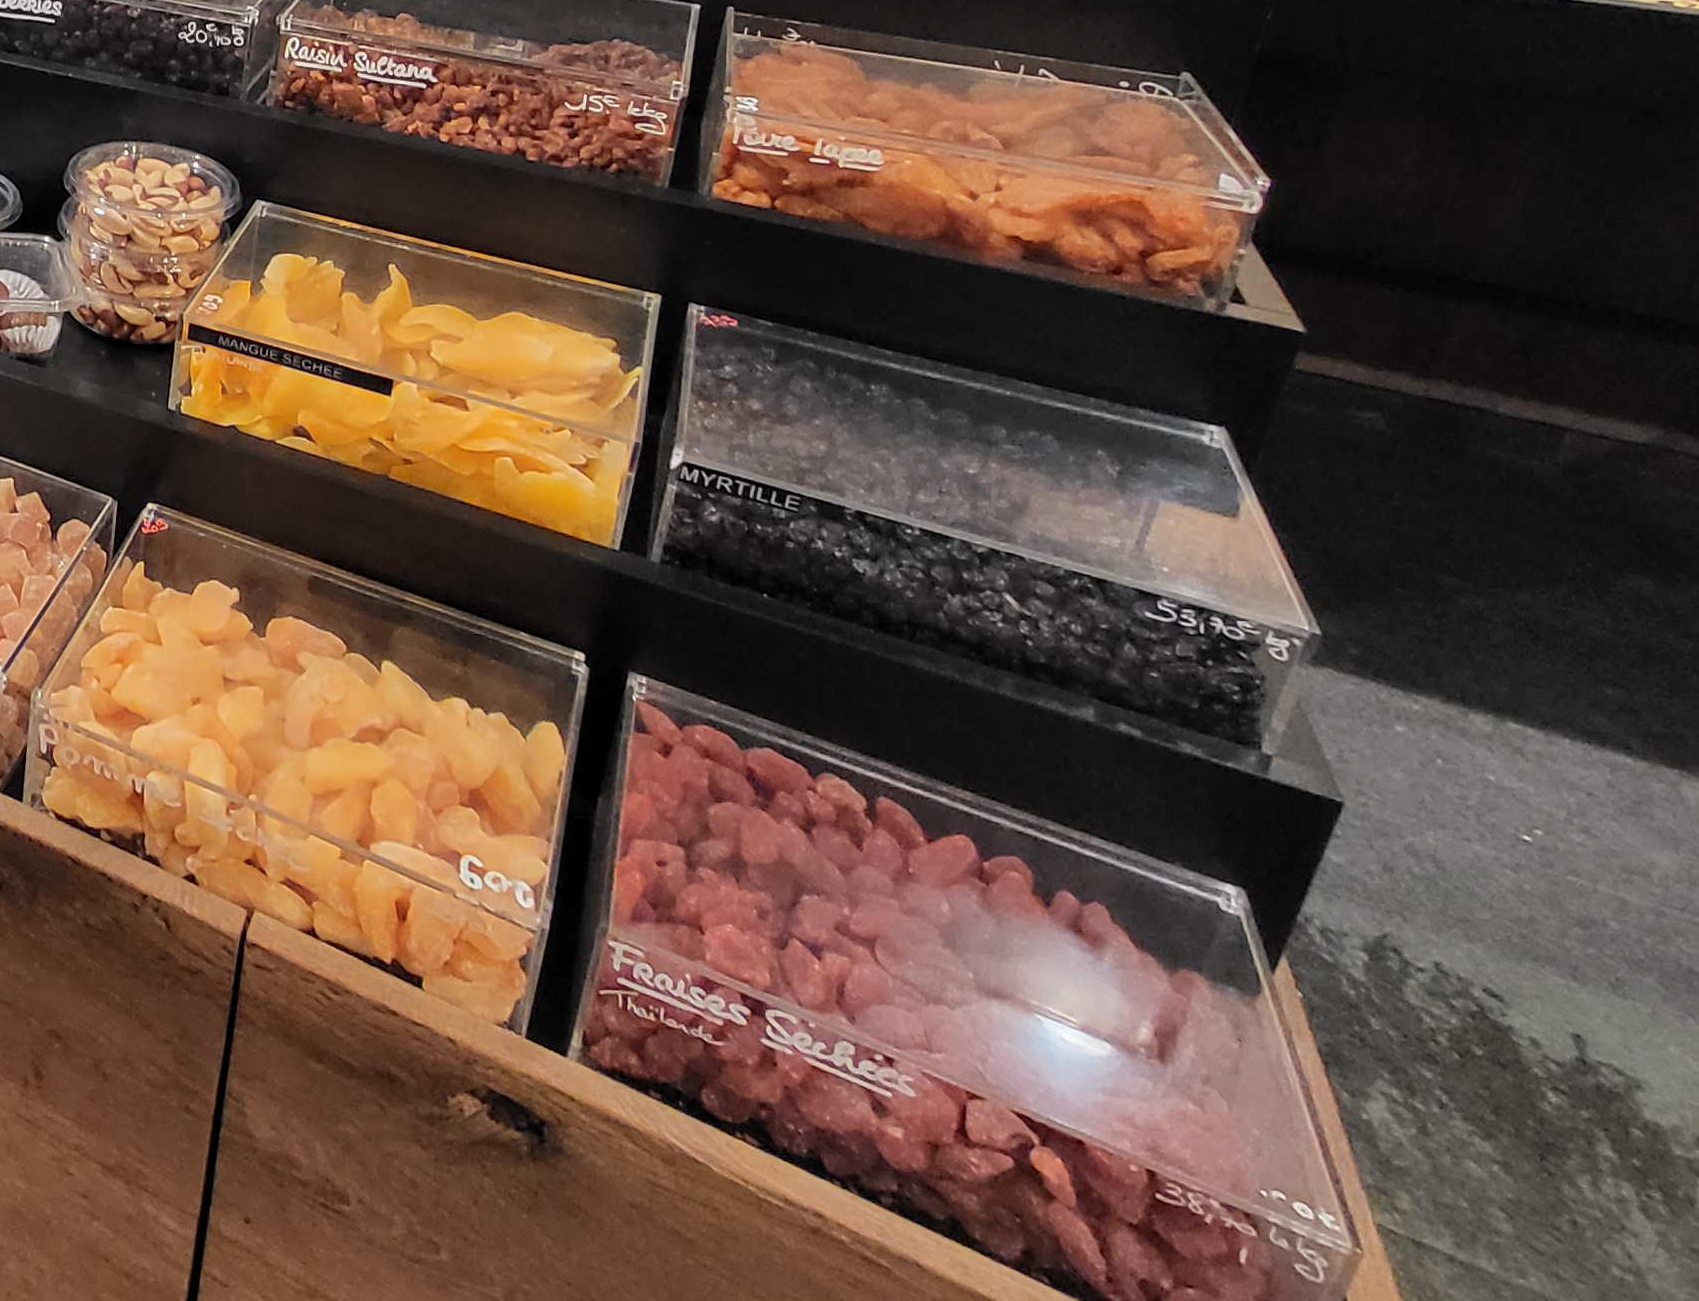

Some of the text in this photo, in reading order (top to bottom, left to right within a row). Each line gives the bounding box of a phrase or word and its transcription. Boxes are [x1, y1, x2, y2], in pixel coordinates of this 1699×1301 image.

[284, 36, 438, 84] Raisin Sultana
[217, 334, 280, 362] MANGUE
[281, 352, 344, 380] SECHEE
[679, 465, 802, 512] MYRTILLE
[608, 940, 751, 1025] Fraises
